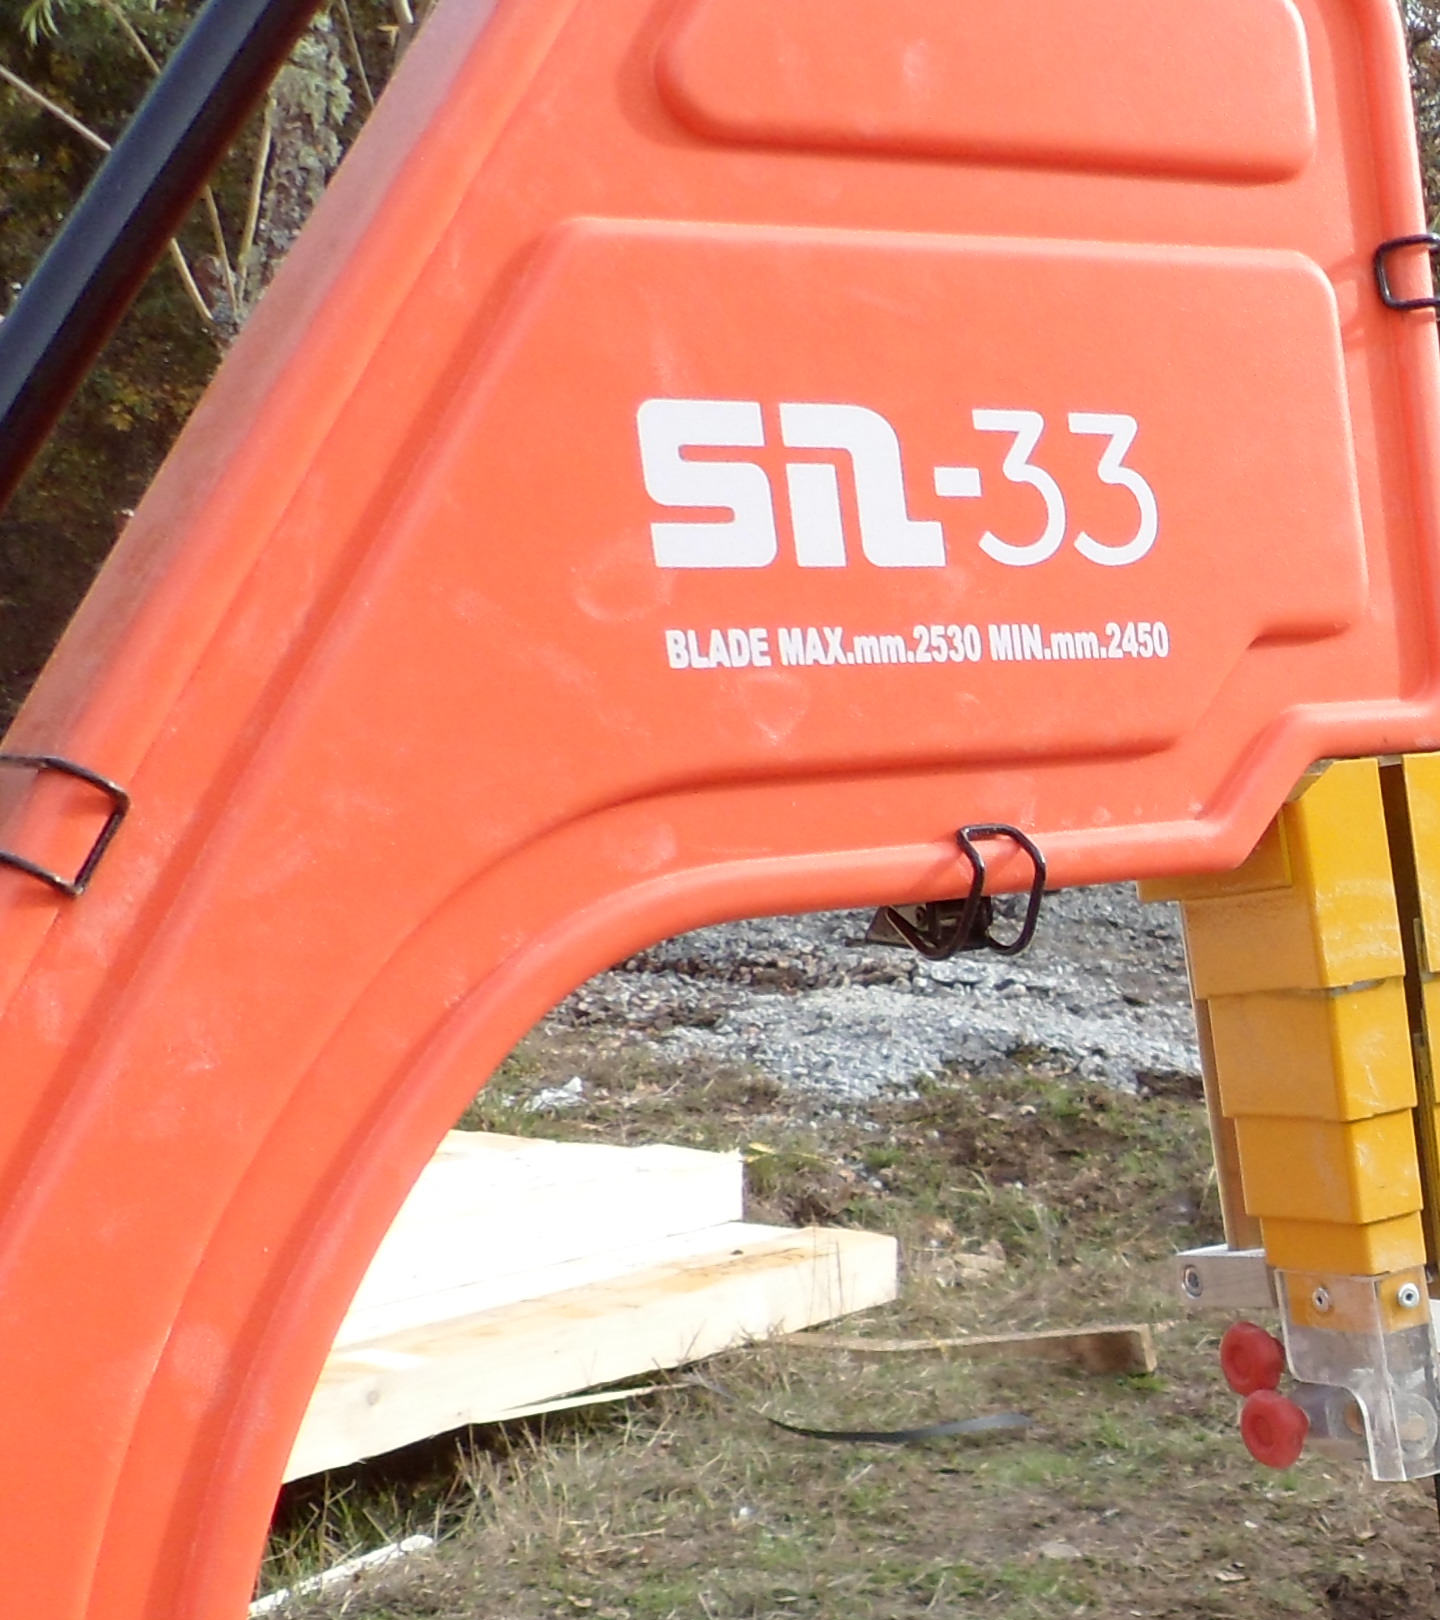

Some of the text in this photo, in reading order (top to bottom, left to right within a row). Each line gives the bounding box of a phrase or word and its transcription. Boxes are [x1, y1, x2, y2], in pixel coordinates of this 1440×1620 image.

[665, 621, 1169, 669] BLADE MAX.mm.2530 MIN.mm.2450
